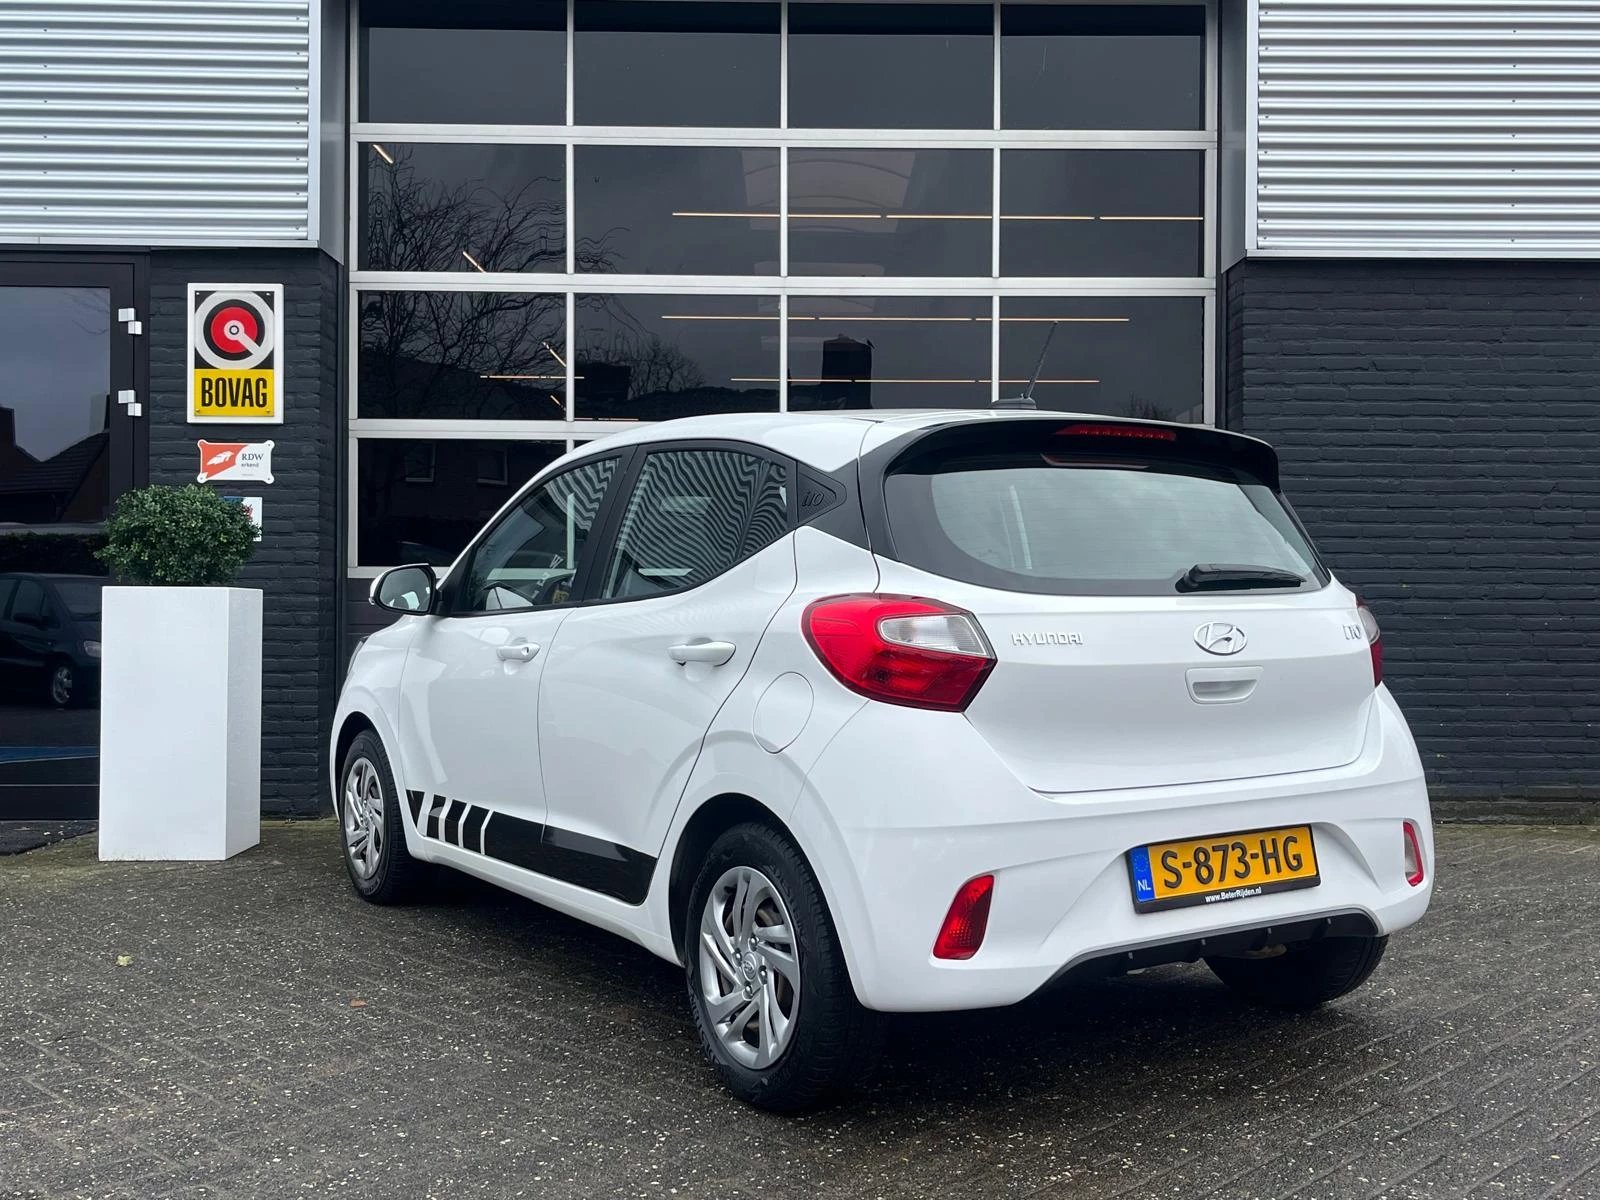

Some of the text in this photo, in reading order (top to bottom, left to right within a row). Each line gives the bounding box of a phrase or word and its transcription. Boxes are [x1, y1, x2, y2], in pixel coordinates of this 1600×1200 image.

[202, 377, 268, 408] BOVAG
[241, 453, 264, 461] RDW
[801, 491, 825, 507] i10
[1011, 632, 1084, 646] HYUNDAI
[1161, 835, 1303, 889] S-873-HG
[1137, 879, 1152, 891] NL
[1205, 886, 1262, 903] www.BeterRijden.nl
